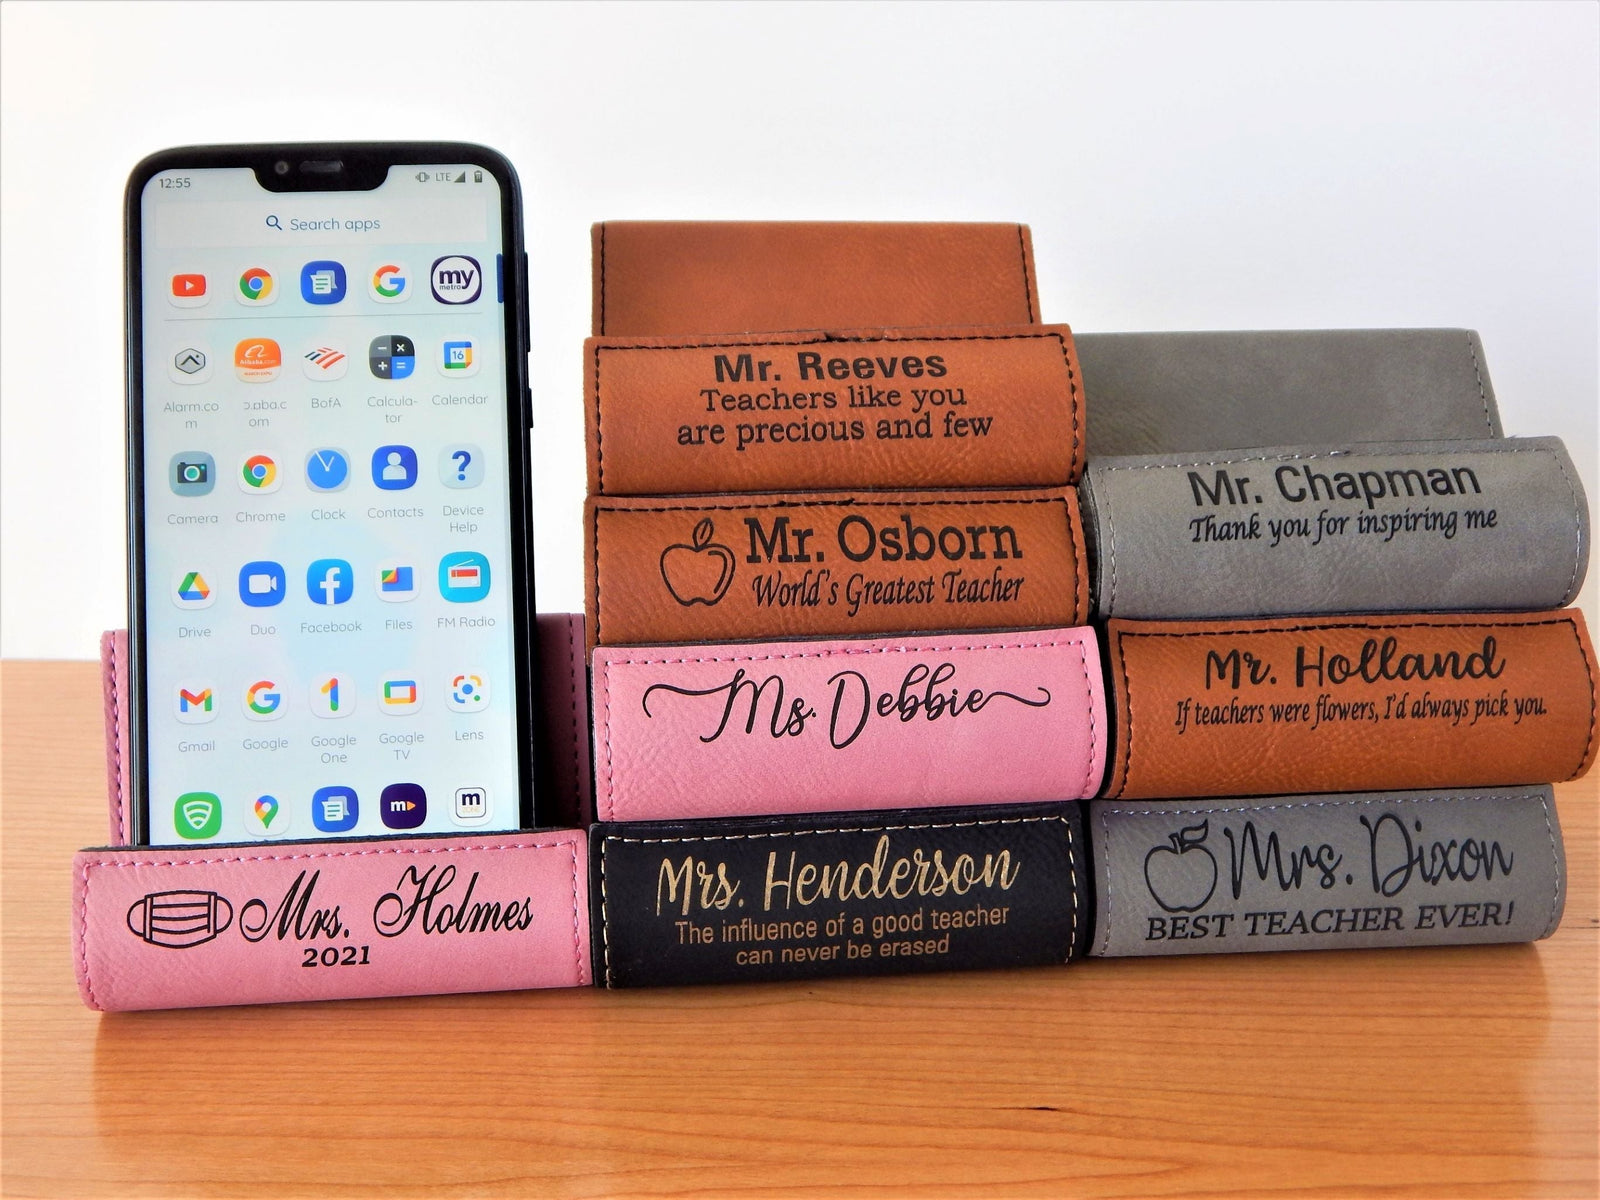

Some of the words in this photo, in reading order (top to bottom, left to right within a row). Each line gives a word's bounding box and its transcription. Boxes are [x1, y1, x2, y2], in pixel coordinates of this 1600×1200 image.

[158, 177, 191, 190] 12:55
[435, 172, 451, 182] LTE
[289, 217, 340, 231] Search
[343, 218, 381, 235] apps
[439, 270, 474, 289] my
[452, 351, 464, 360] 16
[713, 354, 780, 383] Mr.
[799, 351, 947, 381] Reeves
[311, 396, 342, 409] BofA
[367, 396, 418, 407] Calcula-
[431, 394, 488, 406] Calendar
[700, 386, 837, 412] Teachers
[848, 385, 902, 408] like
[911, 385, 968, 411] you
[185, 420, 198, 429] m
[248, 418, 270, 427] om
[385, 414, 402, 423] tor
[677, 423, 725, 445] are
[735, 416, 865, 451] precious
[876, 414, 933, 440] and
[943, 412, 993, 438] few
[1187, 469, 1263, 506] Mr.
[1274, 462, 1481, 509] Chapman
[235, 511, 286, 522] Chrome
[310, 508, 346, 520] Clock
[367, 507, 424, 519] Contacts
[442, 504, 484, 516] Device
[167, 513, 219, 525] Camera
[450, 521, 478, 534] Help
[1189, 511, 1262, 543] Thank
[1269, 516, 1313, 547] you
[1312, 509, 1350, 546] for
[1357, 509, 1458, 542] inspiring
[1464, 507, 1498, 529] me
[743, 515, 824, 564] Mr.
[837, 514, 1023, 561] Osborn
[751, 569, 840, 608] World's
[845, 573, 935, 617] Greatest
[942, 566, 1024, 604] Teacher
[300, 621, 362, 633] Facebook
[385, 618, 413, 630] Files
[437, 617, 455, 627] FM
[458, 616, 495, 628] Radio
[178, 626, 211, 638] Drive
[250, 623, 276, 636] Duo
[1205, 649, 1278, 690] Mr.
[1295, 635, 1506, 688] Holland
[643, 668, 817, 743] Ms.
[827, 662, 1051, 750] Debbie
[1173, 697, 1193, 735] If
[1195, 696, 1264, 727] teachers
[1269, 698, 1310, 723] were
[1312, 694, 1379, 731] flowers,
[1384, 693, 1407, 721] I'd
[1411, 692, 1472, 727] always
[1470, 692, 1509, 727] pick
[1514, 694, 1547, 727] you.
[311, 735, 357, 749] Google
[379, 732, 425, 746] Google
[455, 730, 484, 742] Lens
[178, 740, 216, 753] Gmail
[242, 738, 289, 752] Google
[320, 752, 348, 764] One
[393, 750, 411, 761] TV
[462, 793, 480, 806] m
[1223, 820, 1354, 900] Mrs.
[1359, 813, 1514, 897] Dixon
[656, 857, 744, 917] Mrs.
[764, 835, 1021, 911] Henderson
[239, 869, 350, 942] Mrs.
[373, 864, 534, 938] Holmes
[675, 920, 715, 946] The
[722, 918, 818, 943] influence
[825, 914, 846, 936] of
[852, 917, 865, 934] a
[872, 908, 925, 938] good
[930, 904, 1009, 929] teacher
[1145, 914, 1238, 942] BEST
[1245, 907, 1404, 937] TEACHER
[1415, 901, 1515, 930] EVER!
[301, 946, 371, 967] 2021
[736, 947, 774, 966] can
[781, 943, 841, 963] never
[846, 938, 872, 960] be
[879, 934, 949, 956] erased
